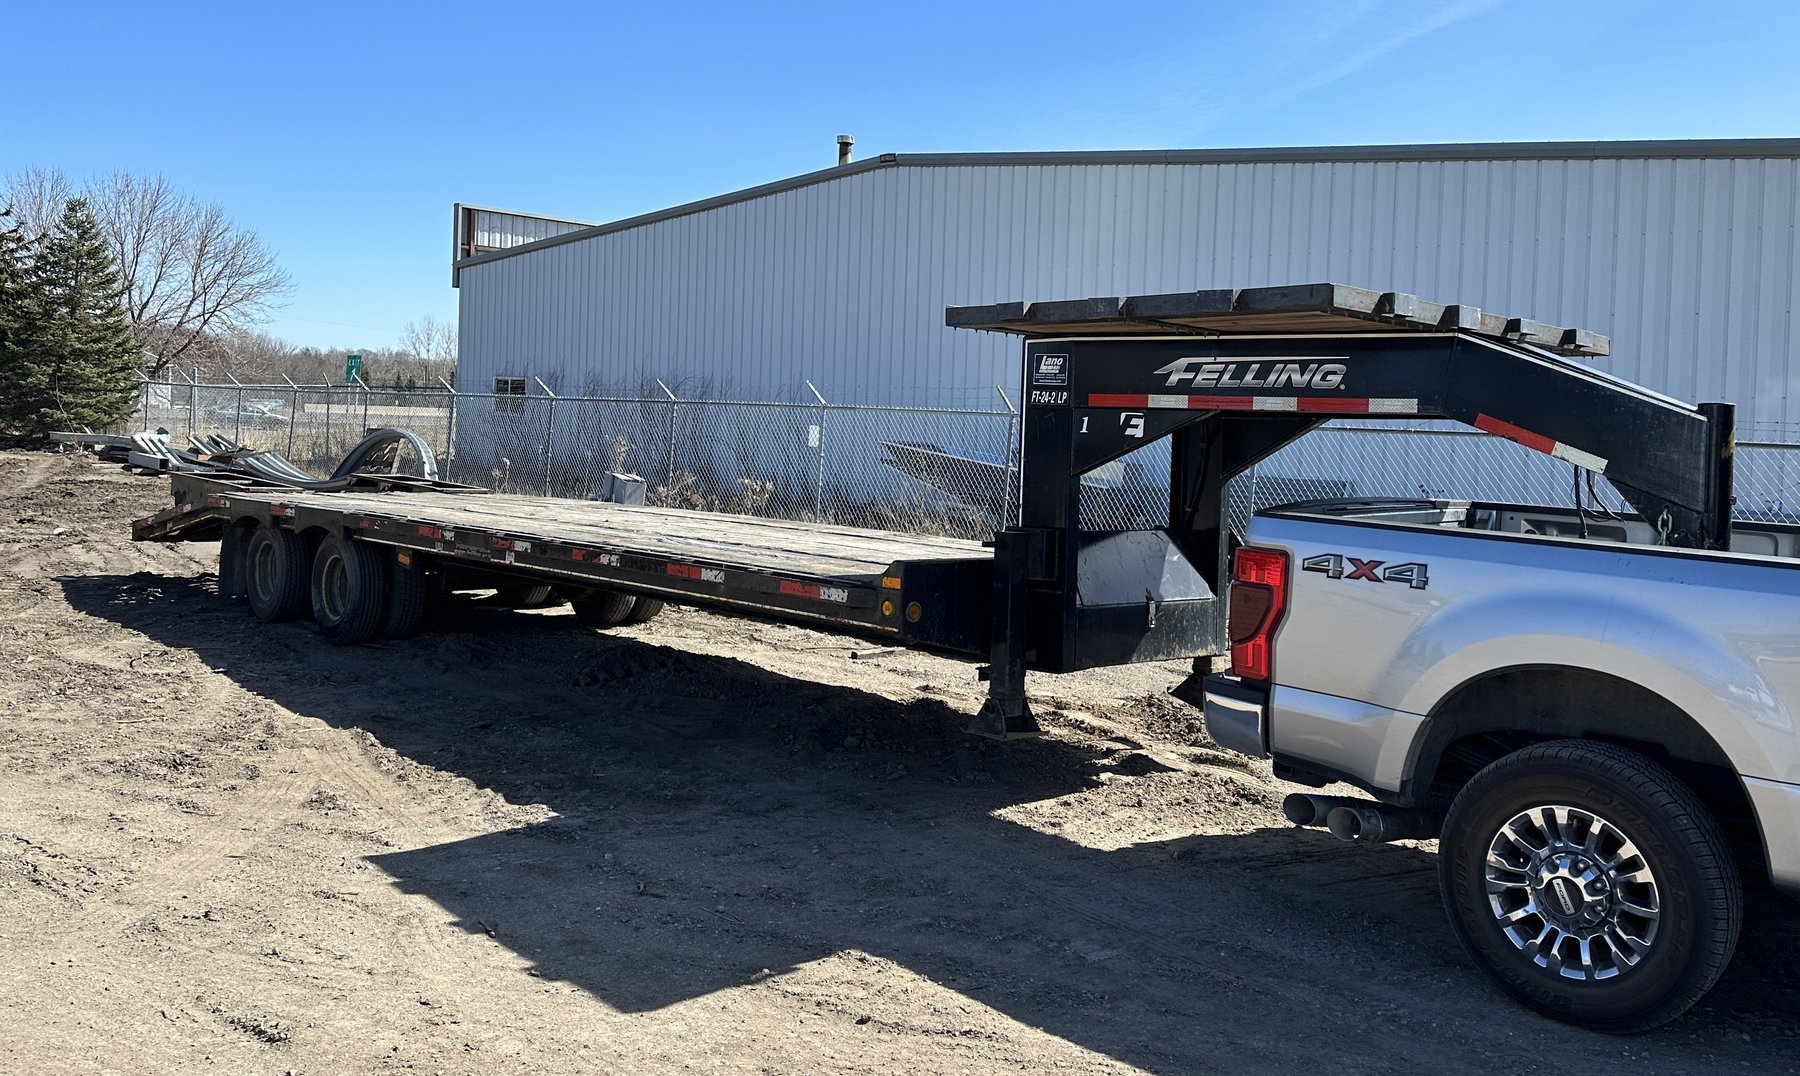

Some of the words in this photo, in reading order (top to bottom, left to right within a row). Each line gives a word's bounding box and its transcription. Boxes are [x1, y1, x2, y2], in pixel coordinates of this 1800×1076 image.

[348, 358, 360, 366] EXIT
[1040, 355, 1064, 368] Lano
[1031, 391, 1056, 404] FT-24-2
[1057, 391, 1068, 404] LP
[1079, 416, 1089, 433] 1
[1555, 881, 1572, 912] FORD
